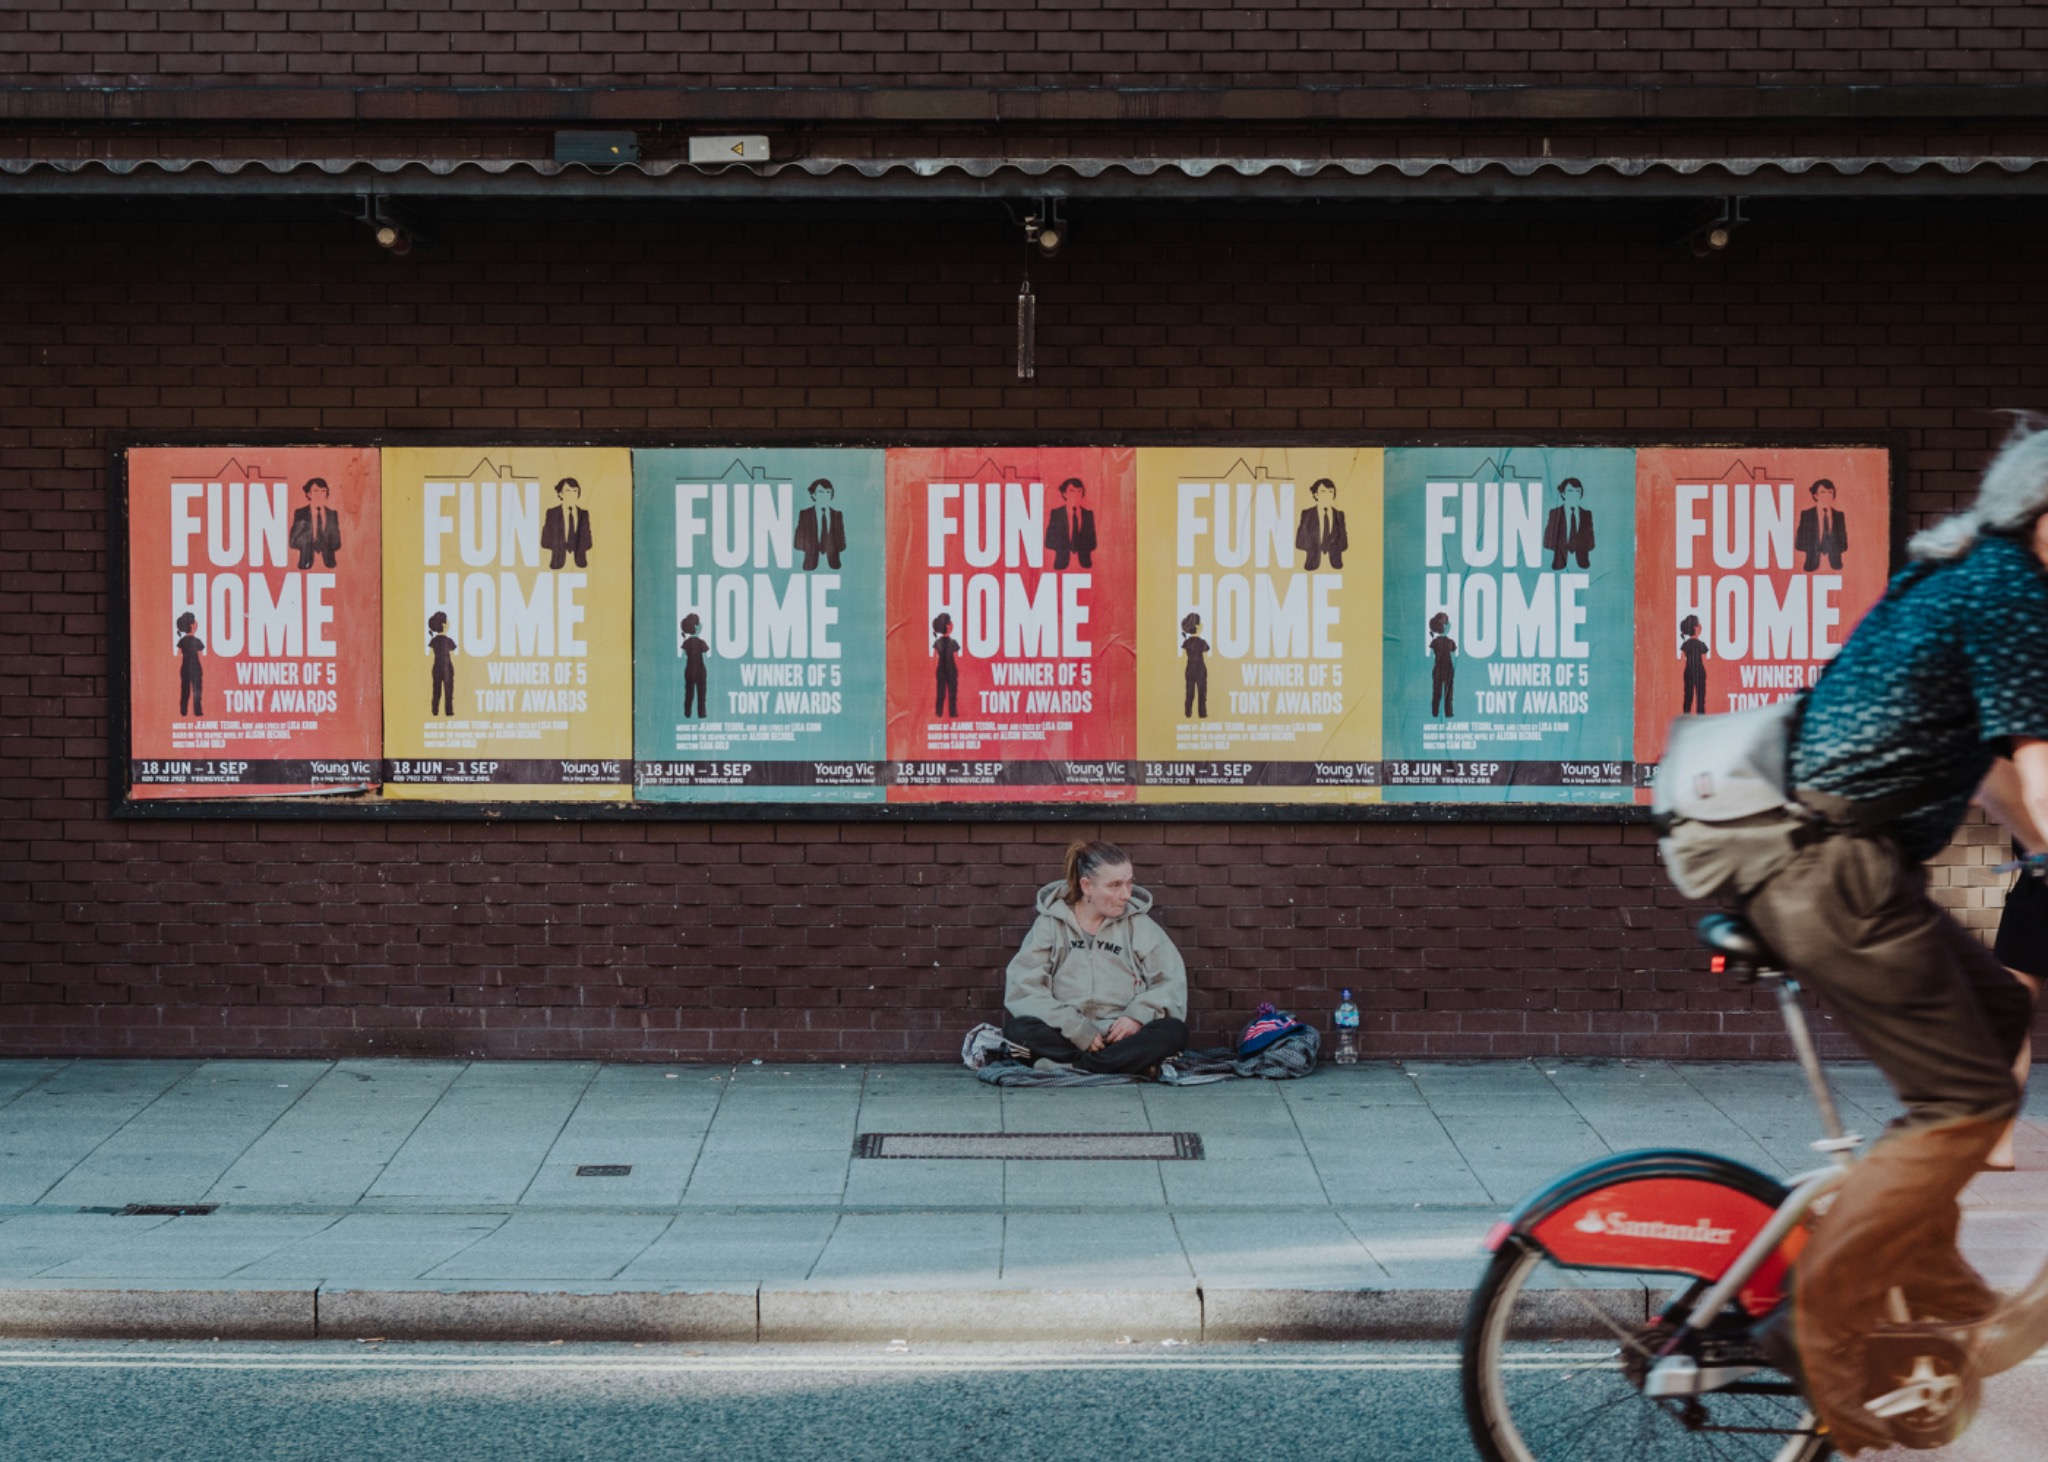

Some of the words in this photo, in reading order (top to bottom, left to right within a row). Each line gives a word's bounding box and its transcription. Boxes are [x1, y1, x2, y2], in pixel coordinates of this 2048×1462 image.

[171, 483, 288, 567] FUN
[424, 482, 540, 567] FUN
[676, 484, 793, 568] FUN
[928, 483, 1044, 567] FUN
[1177, 483, 1294, 569] FUN
[1426, 483, 1542, 567] FUN
[1676, 484, 1794, 569] FUN
[172, 572, 336, 657] HOME
[424, 572, 587, 657] HOME
[677, 574, 841, 659] HOME
[928, 573, 1091, 658] HOME
[1177, 573, 1343, 659] HOME
[1426, 573, 1589, 658] HOME
[1676, 575, 1842, 660] HOME
[235, 663, 299, 685] WINNER
[302, 663, 323, 685] OF
[326, 663, 337, 685] 5
[486, 662, 551, 685] WINNER
[553, 662, 573, 685] OF
[575, 662, 587, 685] 5
[740, 664, 804, 686] WINNER
[807, 664, 827, 686] OF
[830, 664, 842, 686] 5
[991, 663, 1055, 686] WINNER
[1057, 663, 1078, 686] OF
[1081, 663, 1092, 686] 5
[1241, 664, 1305, 687] WINNER
[1308, 664, 1329, 687] OF
[1332, 664, 1343, 687] 5
[1487, 664, 1552, 686] WINNER
[1555, 664, 1575, 686] OF
[1578, 664, 1589, 686] 5
[1740, 665, 1804, 688] WINNER
[223, 690, 266, 713] TONY
[270, 690, 338, 713] AWARDS
[474, 689, 517, 712] TONY
[520, 689, 588, 712] AWARDS
[727, 692, 770, 714] TONY
[774, 692, 842, 714] AWARDS
[978, 691, 1021, 713] TONY
[1025, 691, 1093, 713] AWARDS
[1228, 691, 1271, 714] TONY
[1275, 691, 1344, 714] AWARDS
[1475, 691, 1518, 714] TONY
[1522, 691, 1589, 714] AWARDS
[141, 761, 159, 775] 18
[161, 761, 192, 775] JUN
[206, 761, 216, 775] 1
[219, 761, 248, 775] SEP
[309, 761, 350, 777] Young
[351, 761, 371, 774] Vic
[393, 761, 411, 775] 18
[413, 761, 443, 775] JUN
[457, 761, 466, 775] 1
[470, 761, 499, 775] SEP
[560, 761, 599, 777] Young
[601, 761, 621, 774] Vic
[645, 763, 663, 777] 18
[665, 763, 695, 777] JUN
[710, 763, 719, 777] 1
[723, 763, 752, 777] SEP
[814, 762, 854, 778] Young
[855, 762, 875, 775] Vic
[896, 762, 915, 776] 18
[916, 762, 947, 776] JUN
[961, 762, 971, 776] 1
[974, 762, 1003, 776] SEP
[1064, 761, 1104, 778] Young
[1106, 761, 1126, 774] Vic
[1145, 763, 1163, 777] 18
[1165, 763, 1196, 777] JUN
[1210, 763, 1219, 777] 1
[1223, 763, 1253, 777] SEP
[1314, 762, 1354, 778] Young
[1355, 762, 1375, 775] Vic
[1392, 762, 1410, 776] 18
[1412, 762, 1442, 776] JUN
[1457, 762, 1466, 776] 1
[1469, 762, 1500, 776] SEP
[1560, 762, 1600, 778] Young
[1602, 762, 1622, 775] Vic
[1068, 940, 1122, 956] NZYME
[1604, 1211, 1736, 1245] Santander
